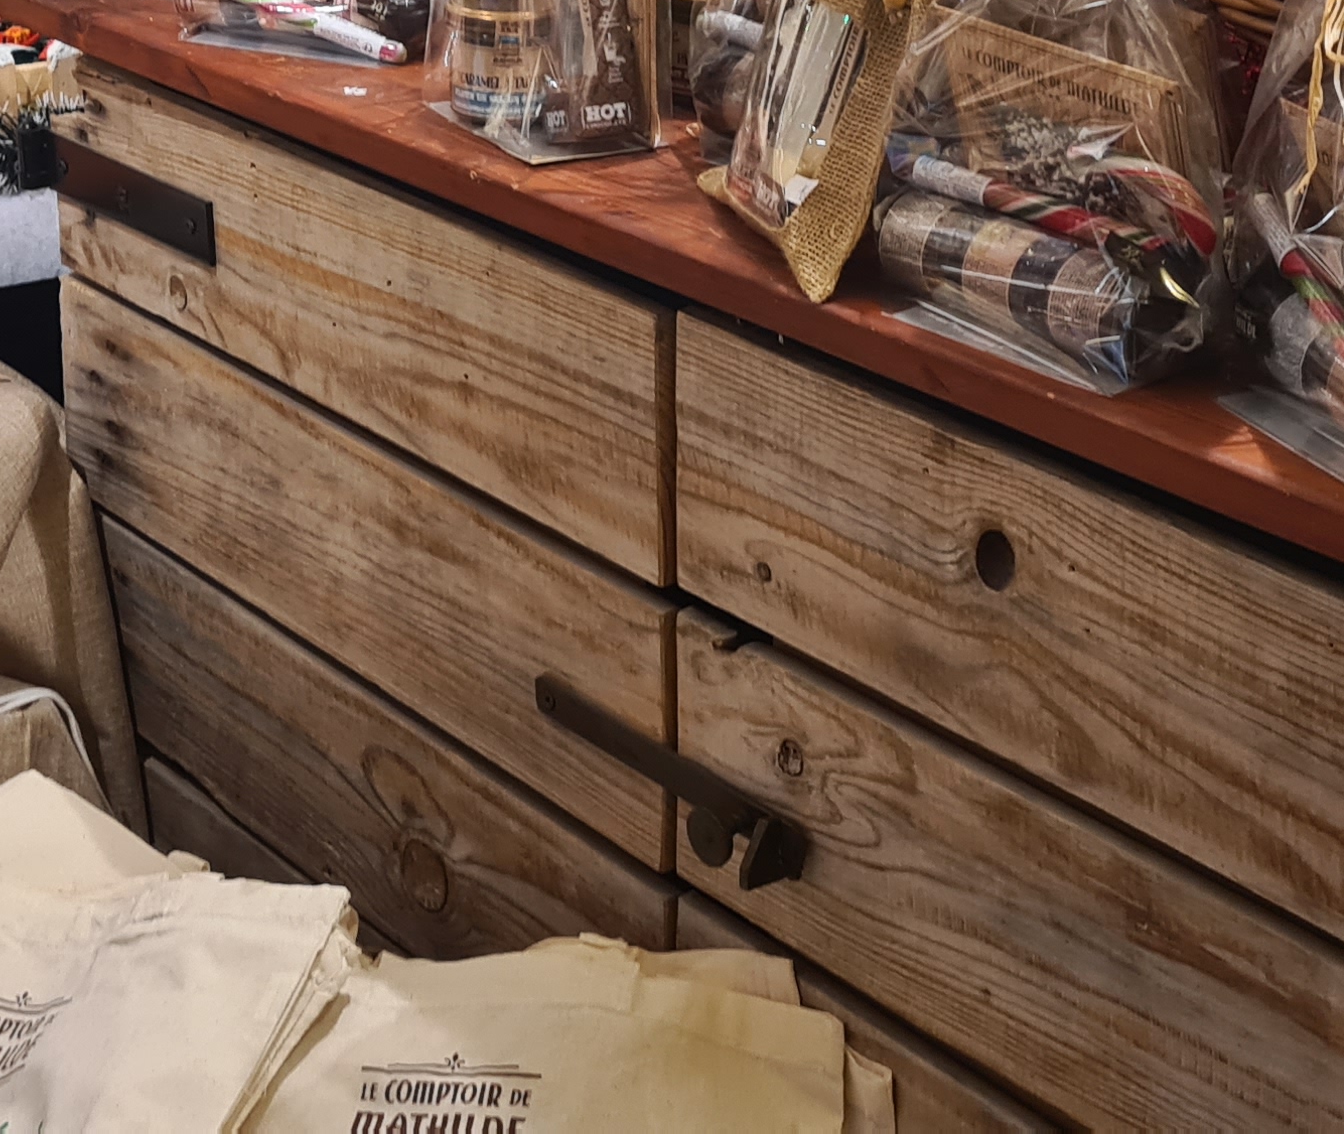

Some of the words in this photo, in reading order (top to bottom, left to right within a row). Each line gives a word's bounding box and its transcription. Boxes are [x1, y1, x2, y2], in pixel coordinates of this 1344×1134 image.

[585, 102, 627, 123] HOT
[360, 1081, 378, 1103] LE
[383, 1078, 503, 1108] COMPTOIR
[509, 1087, 533, 1108] DE
[350, 1110, 526, 1134] MATHILDE
